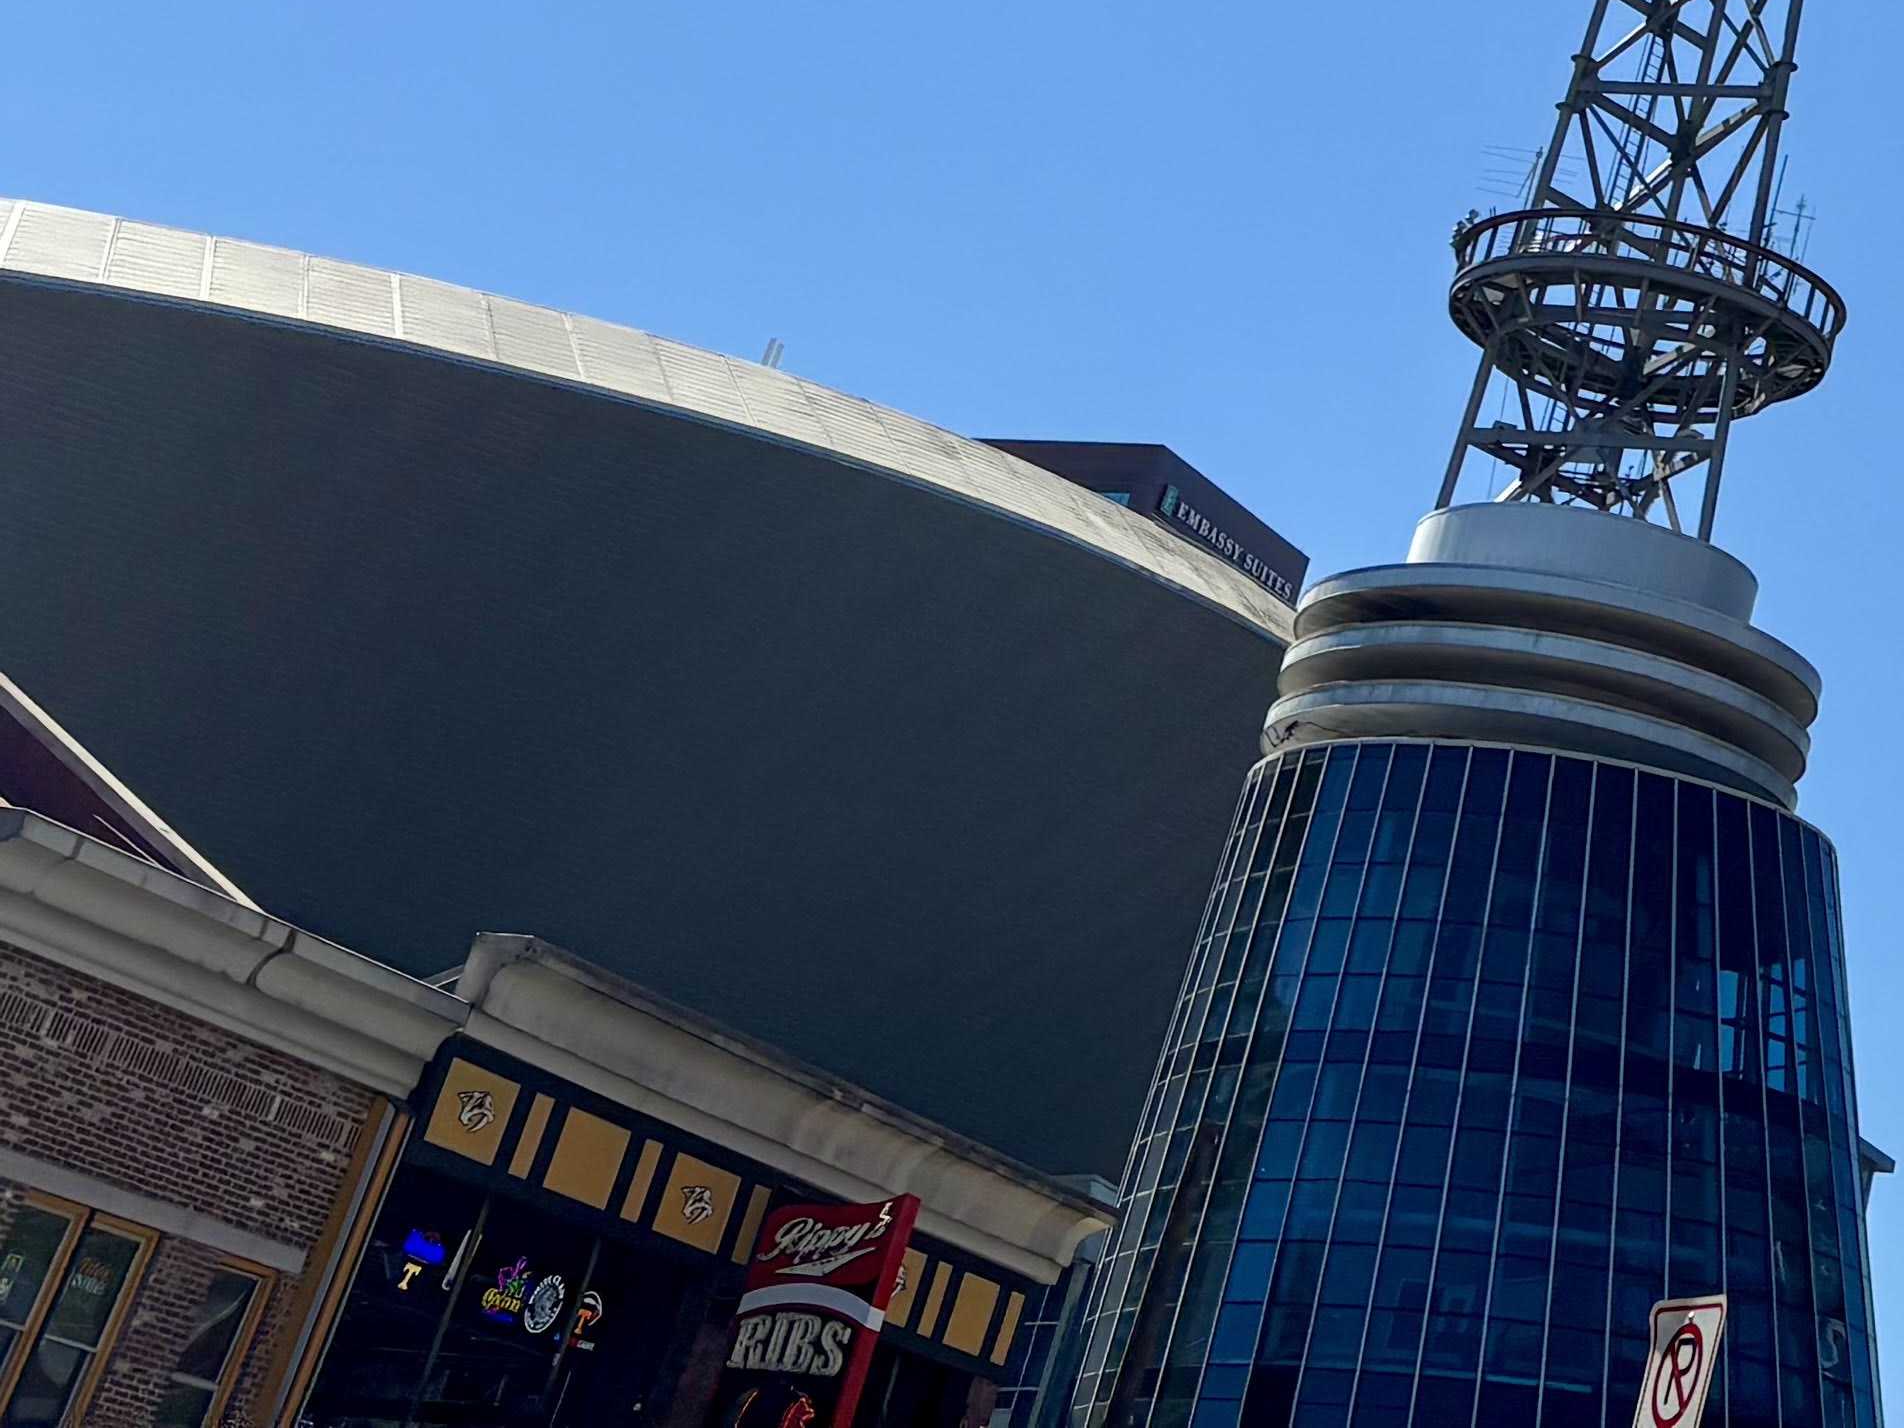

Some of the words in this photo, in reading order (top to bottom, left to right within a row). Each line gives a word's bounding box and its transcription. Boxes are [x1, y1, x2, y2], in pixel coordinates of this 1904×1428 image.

[1177, 501, 1244, 561] EMBASSY
[1243, 553, 1293, 599] SUITES
[756, 1201, 893, 1266] Rippy's
[726, 1311, 852, 1377] RIBS
